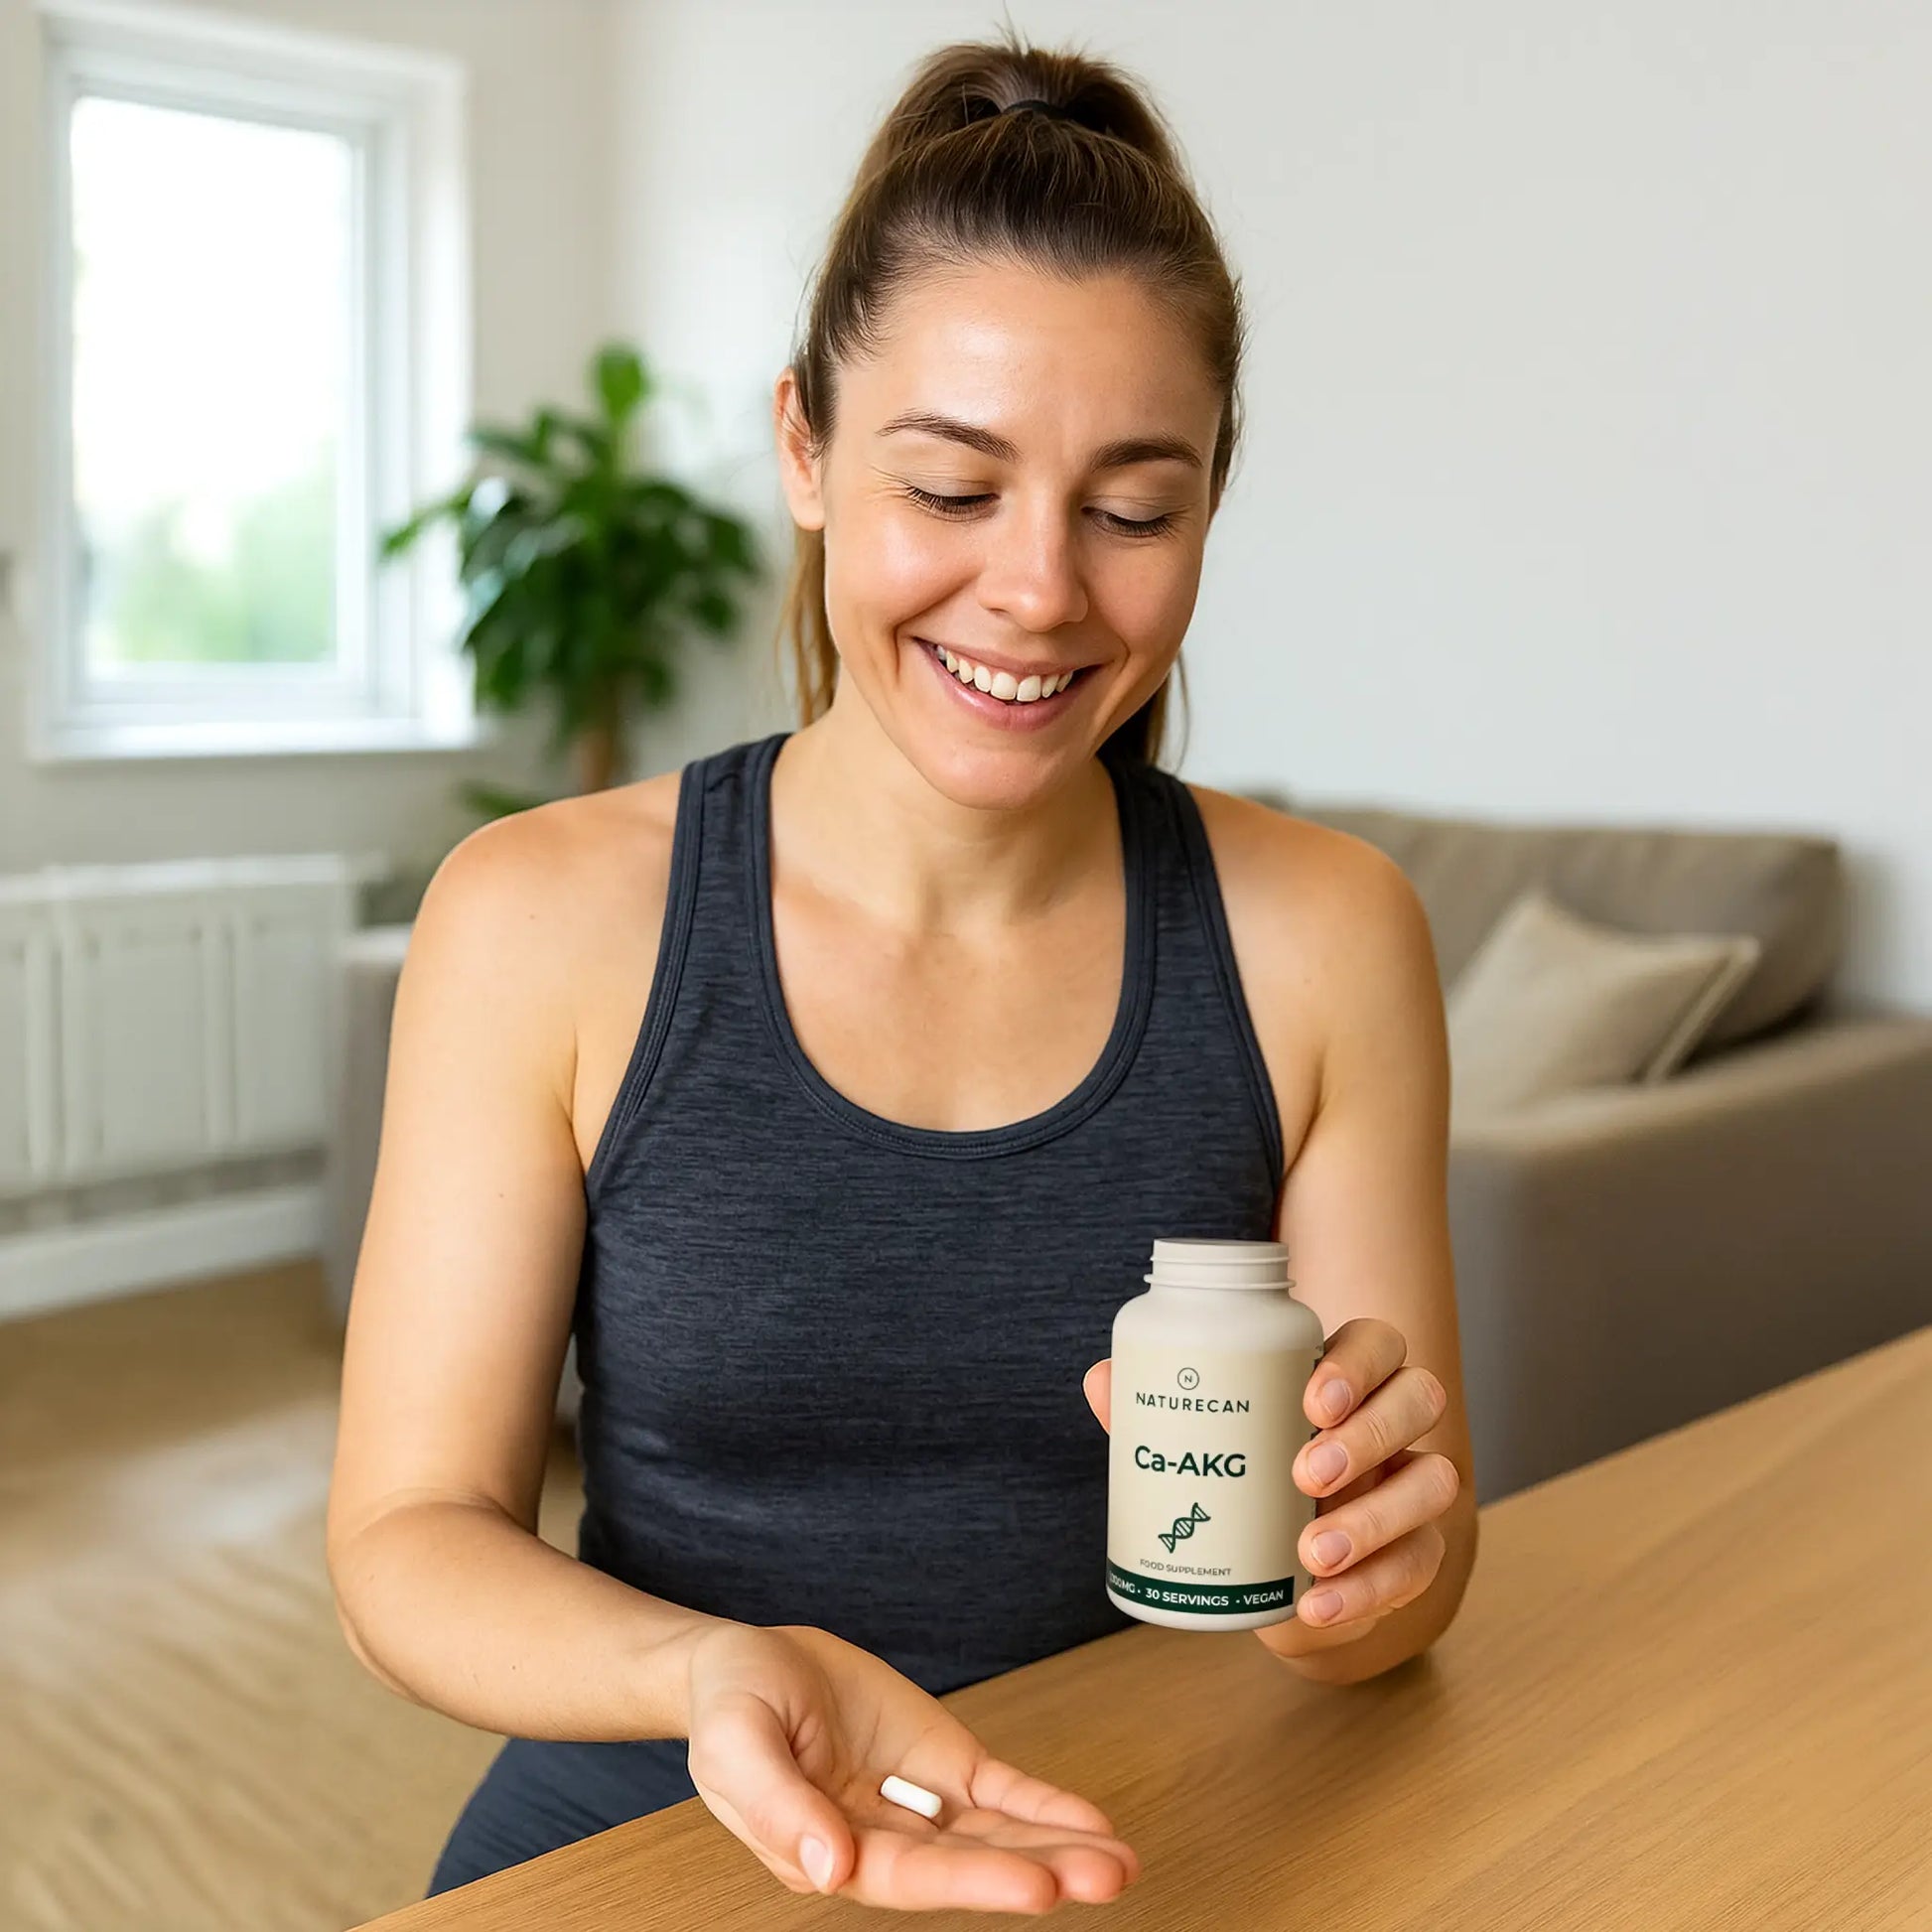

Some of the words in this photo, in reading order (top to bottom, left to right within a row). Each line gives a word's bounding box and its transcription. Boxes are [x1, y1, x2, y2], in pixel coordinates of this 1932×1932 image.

[1136, 1391, 1250, 1413] NATURECAN
[1134, 1445, 1246, 1478] Ca-AKG
[1140, 1559, 1165, 1572] FOOD
[1166, 1564, 1232, 1577] SUPPLEMENT
[1145, 1587, 1161, 1600] 30
[1162, 1590, 1229, 1607] SERVINGS
[1243, 1588, 1284, 1606] VEGAN
